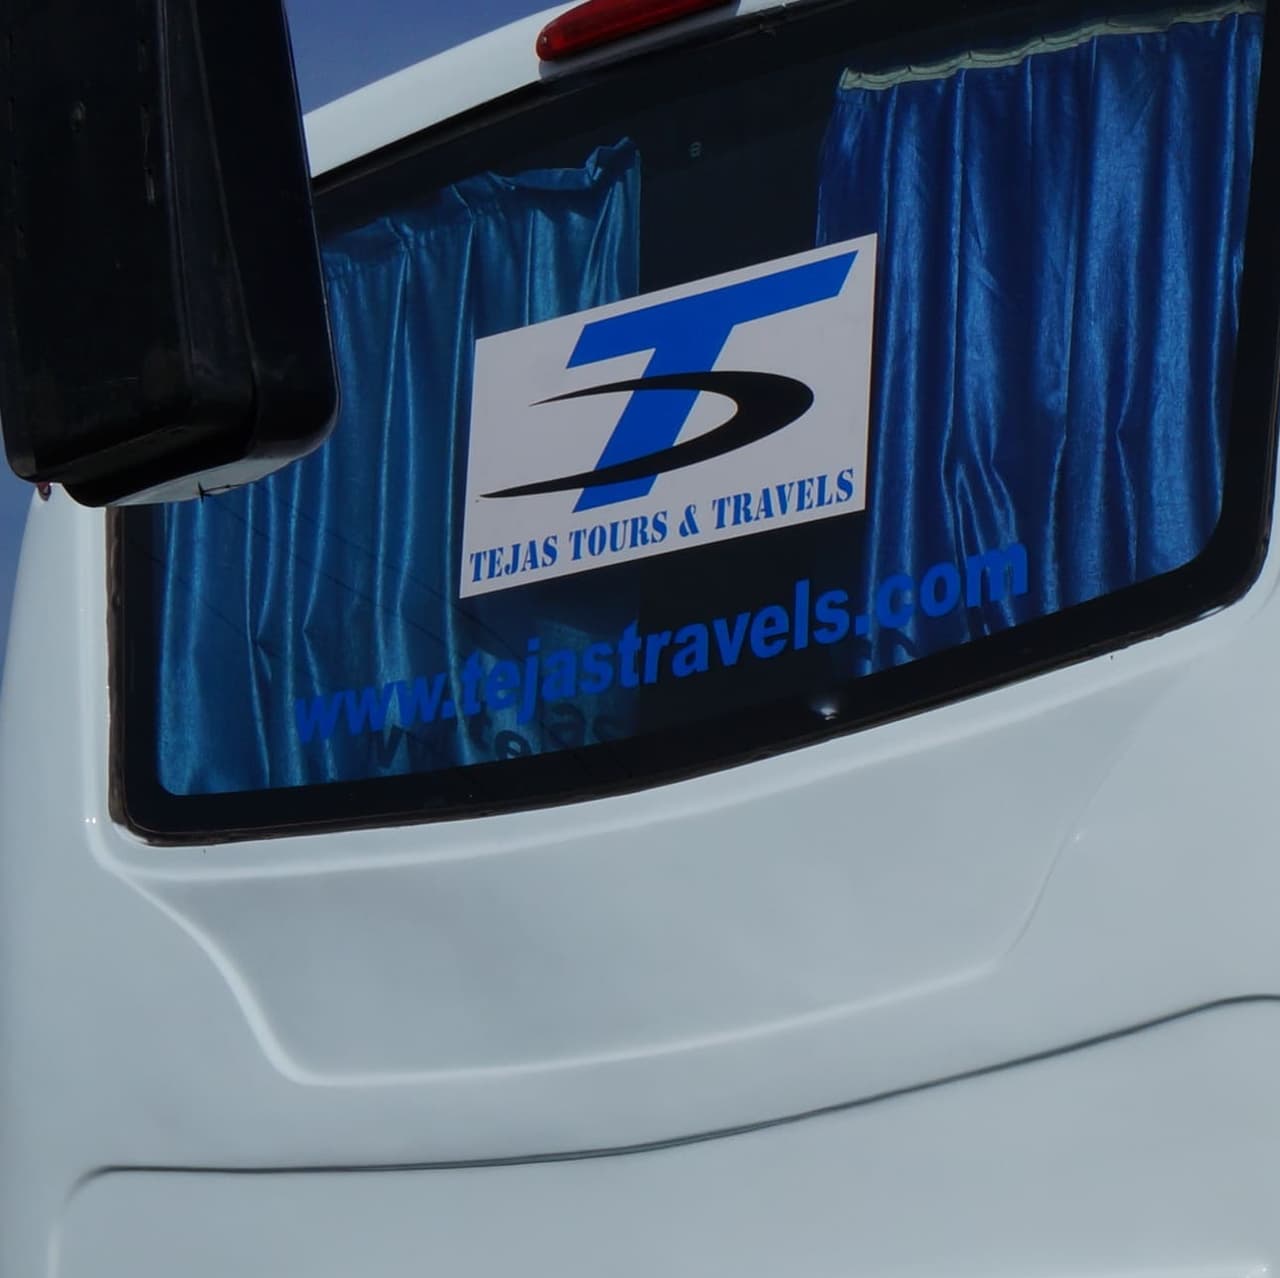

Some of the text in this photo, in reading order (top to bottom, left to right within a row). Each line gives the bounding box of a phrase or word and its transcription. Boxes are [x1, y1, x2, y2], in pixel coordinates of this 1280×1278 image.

[469, 468, 855, 583] TEJAS TOURS & TRAVELS
[294, 542, 1029, 745] www.tejastravels.com
